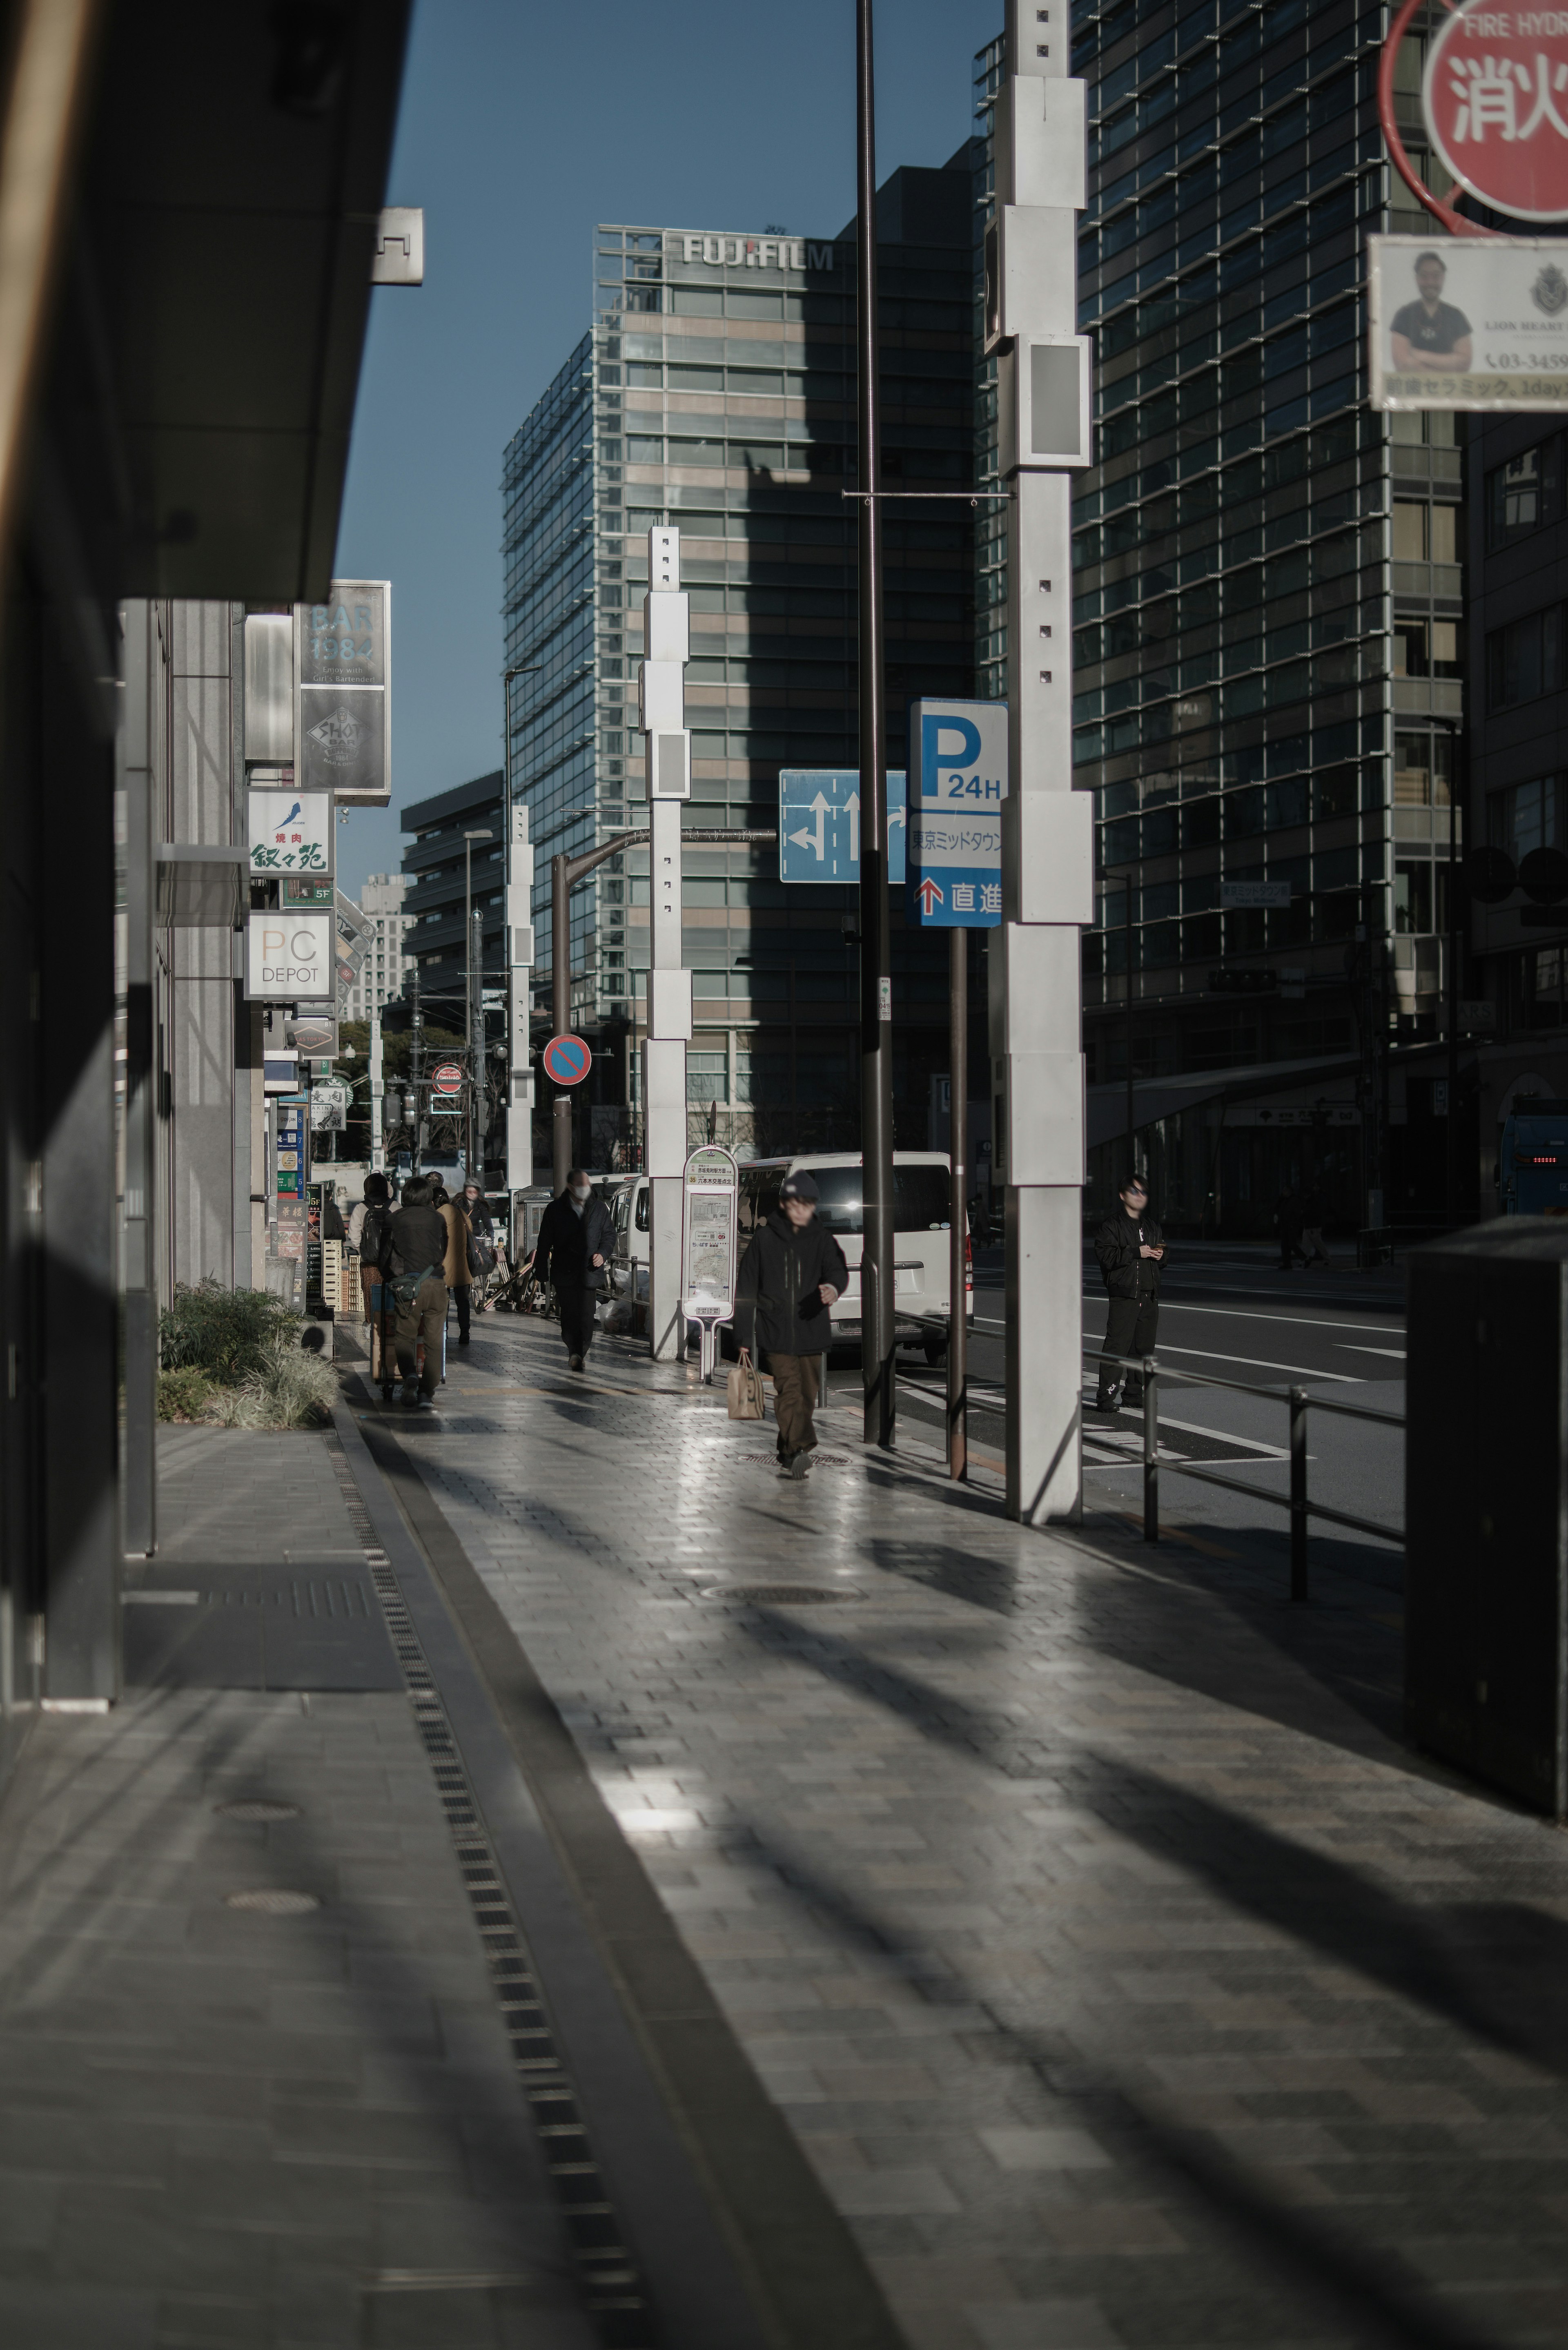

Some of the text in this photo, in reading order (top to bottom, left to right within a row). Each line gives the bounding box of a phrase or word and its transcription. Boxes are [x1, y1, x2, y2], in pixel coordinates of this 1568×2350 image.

[1465, 13, 1511, 38] FIRE
[1448, 53, 1568, 142] 消火
[683, 236, 833, 271] FUJIFILM
[1485, 321, 1564, 330] LION HEART
[312, 606, 372, 631] BAR
[310, 638, 373, 660] 1984
[319, 721, 363, 739] SHOT
[922, 714, 981, 797] P
[948, 774, 1000, 800] 24H
[276, 834, 302, 843] 焼肉
[913, 830, 1001, 852] 東京ミッドタウン
[316, 890, 330, 898] 5F
[951, 883, 1002, 914] 直進
[1223, 885, 1288, 896] 東京ミッドタウン前
[263, 931, 316, 961] PC
[263, 968, 318, 982] DEPOT
